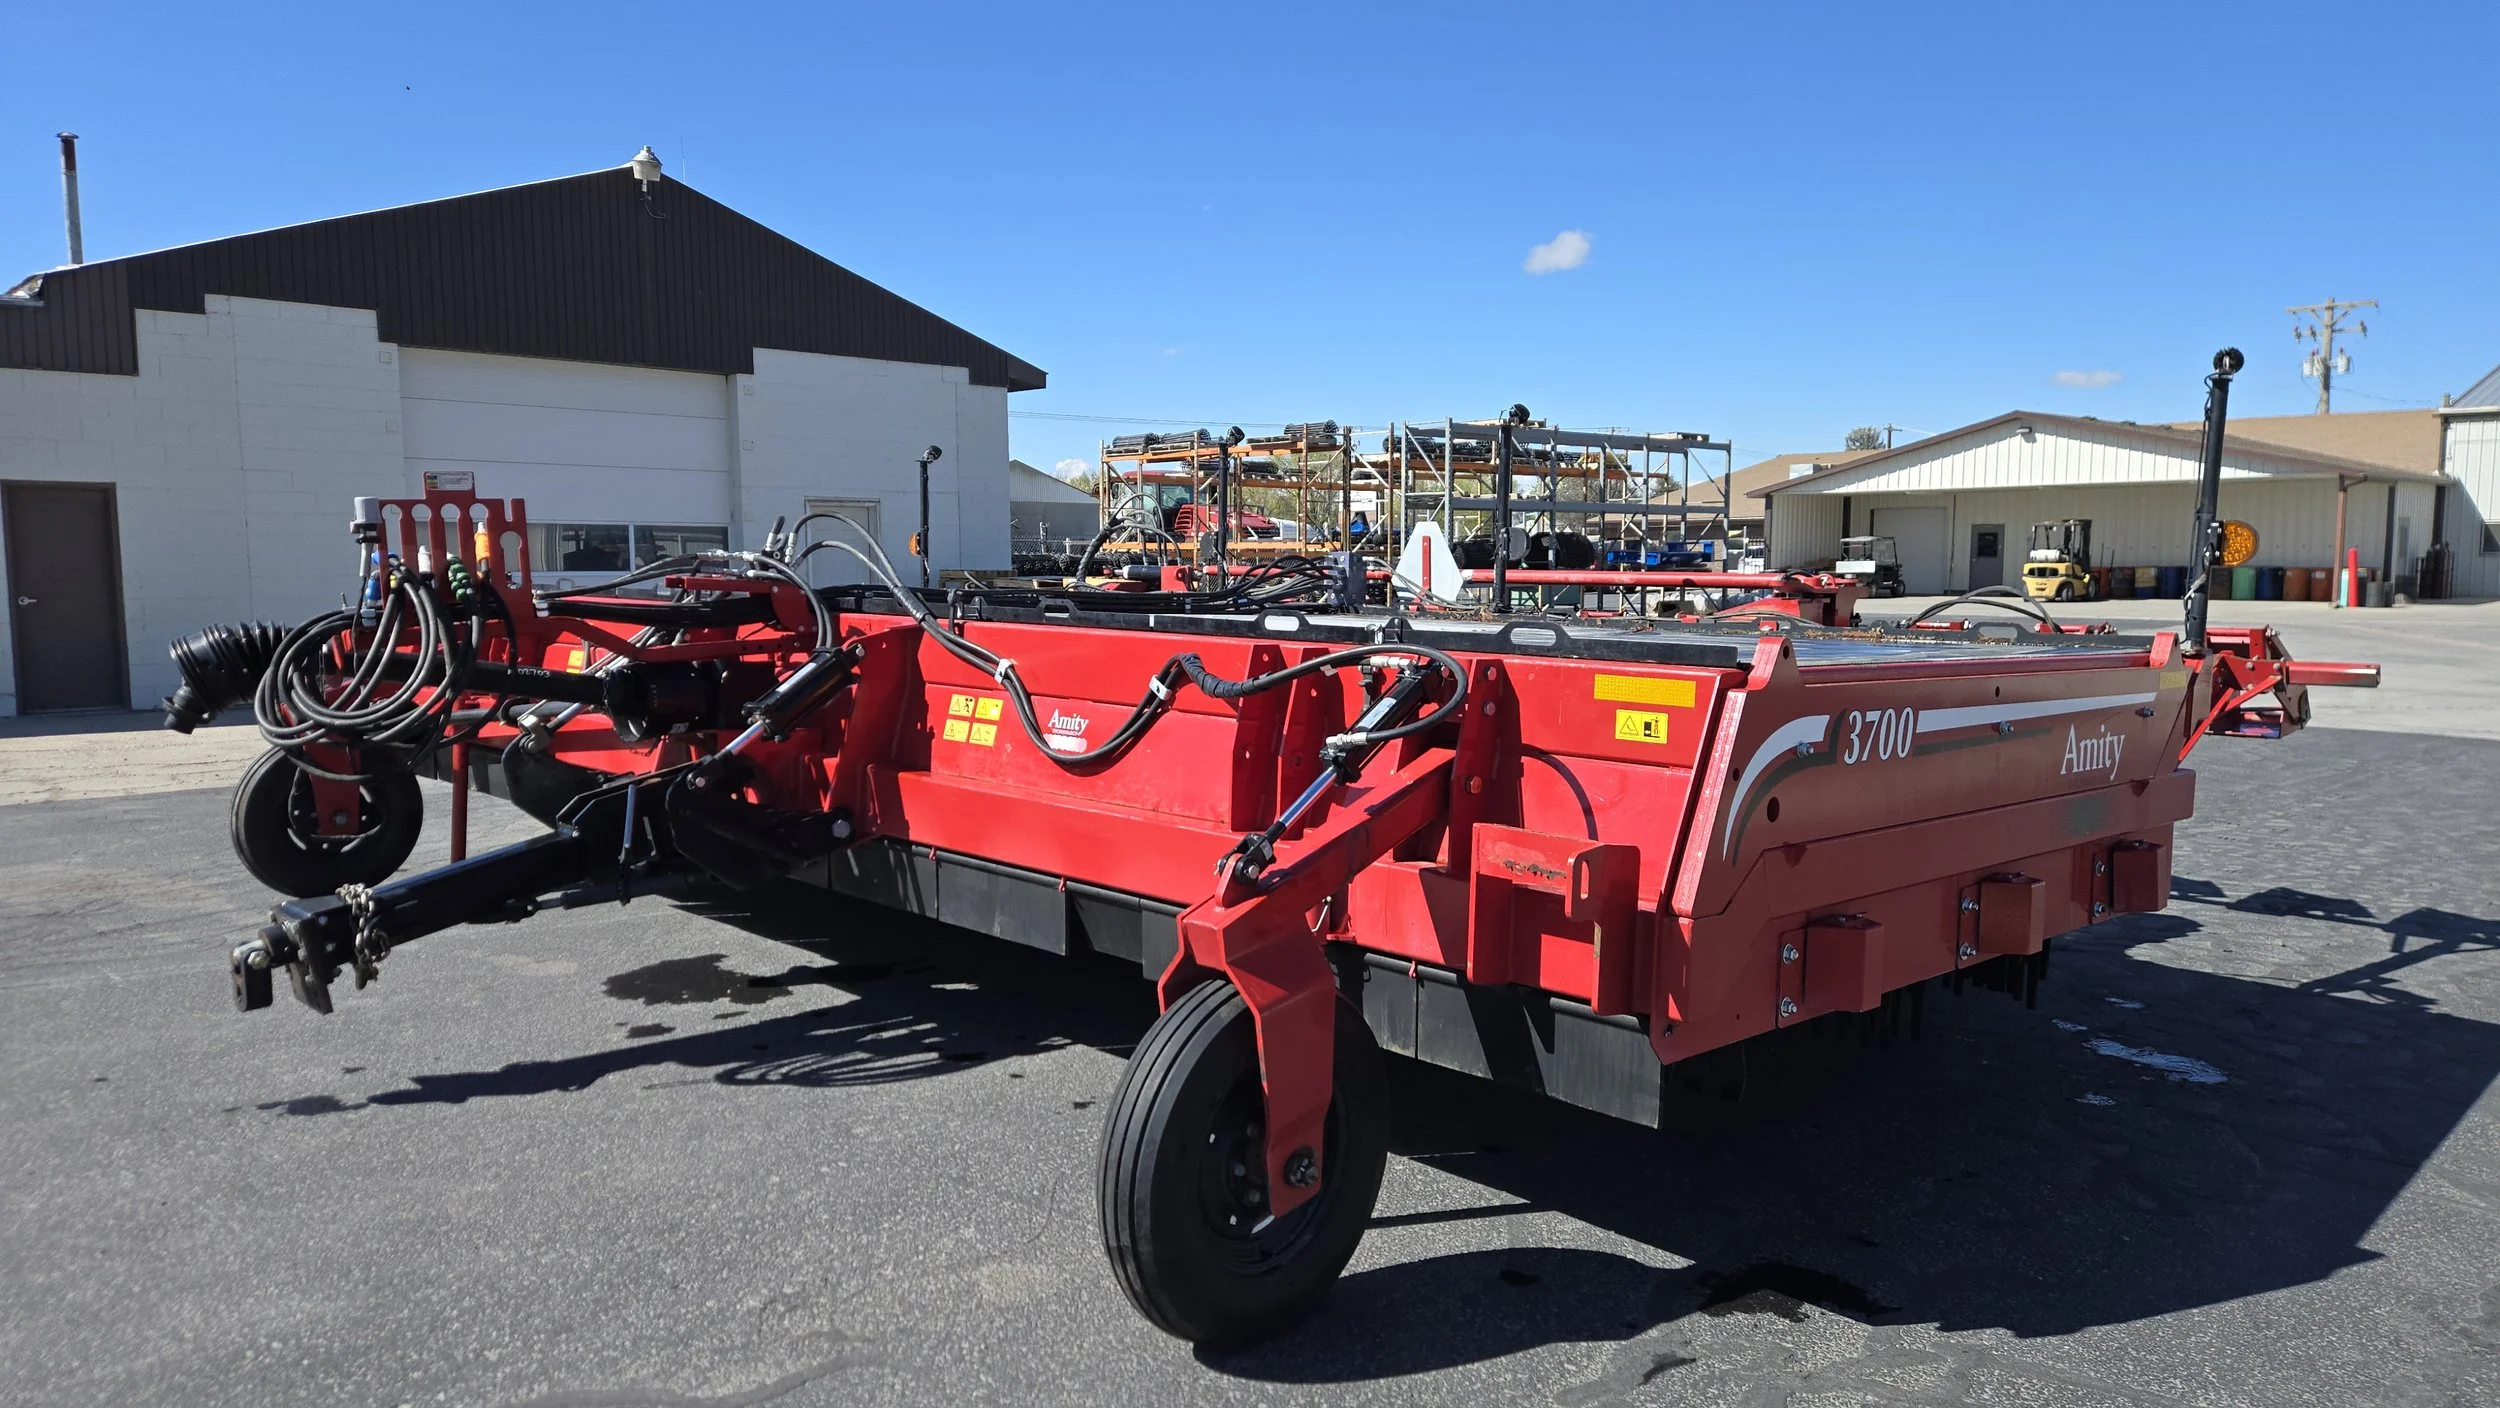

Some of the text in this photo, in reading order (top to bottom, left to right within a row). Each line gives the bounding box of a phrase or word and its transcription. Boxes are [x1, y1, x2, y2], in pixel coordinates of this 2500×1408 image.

[1047, 708, 1089, 736] Amity
[1843, 706, 1914, 765] 3700
[2060, 724, 2125, 781] Amity
